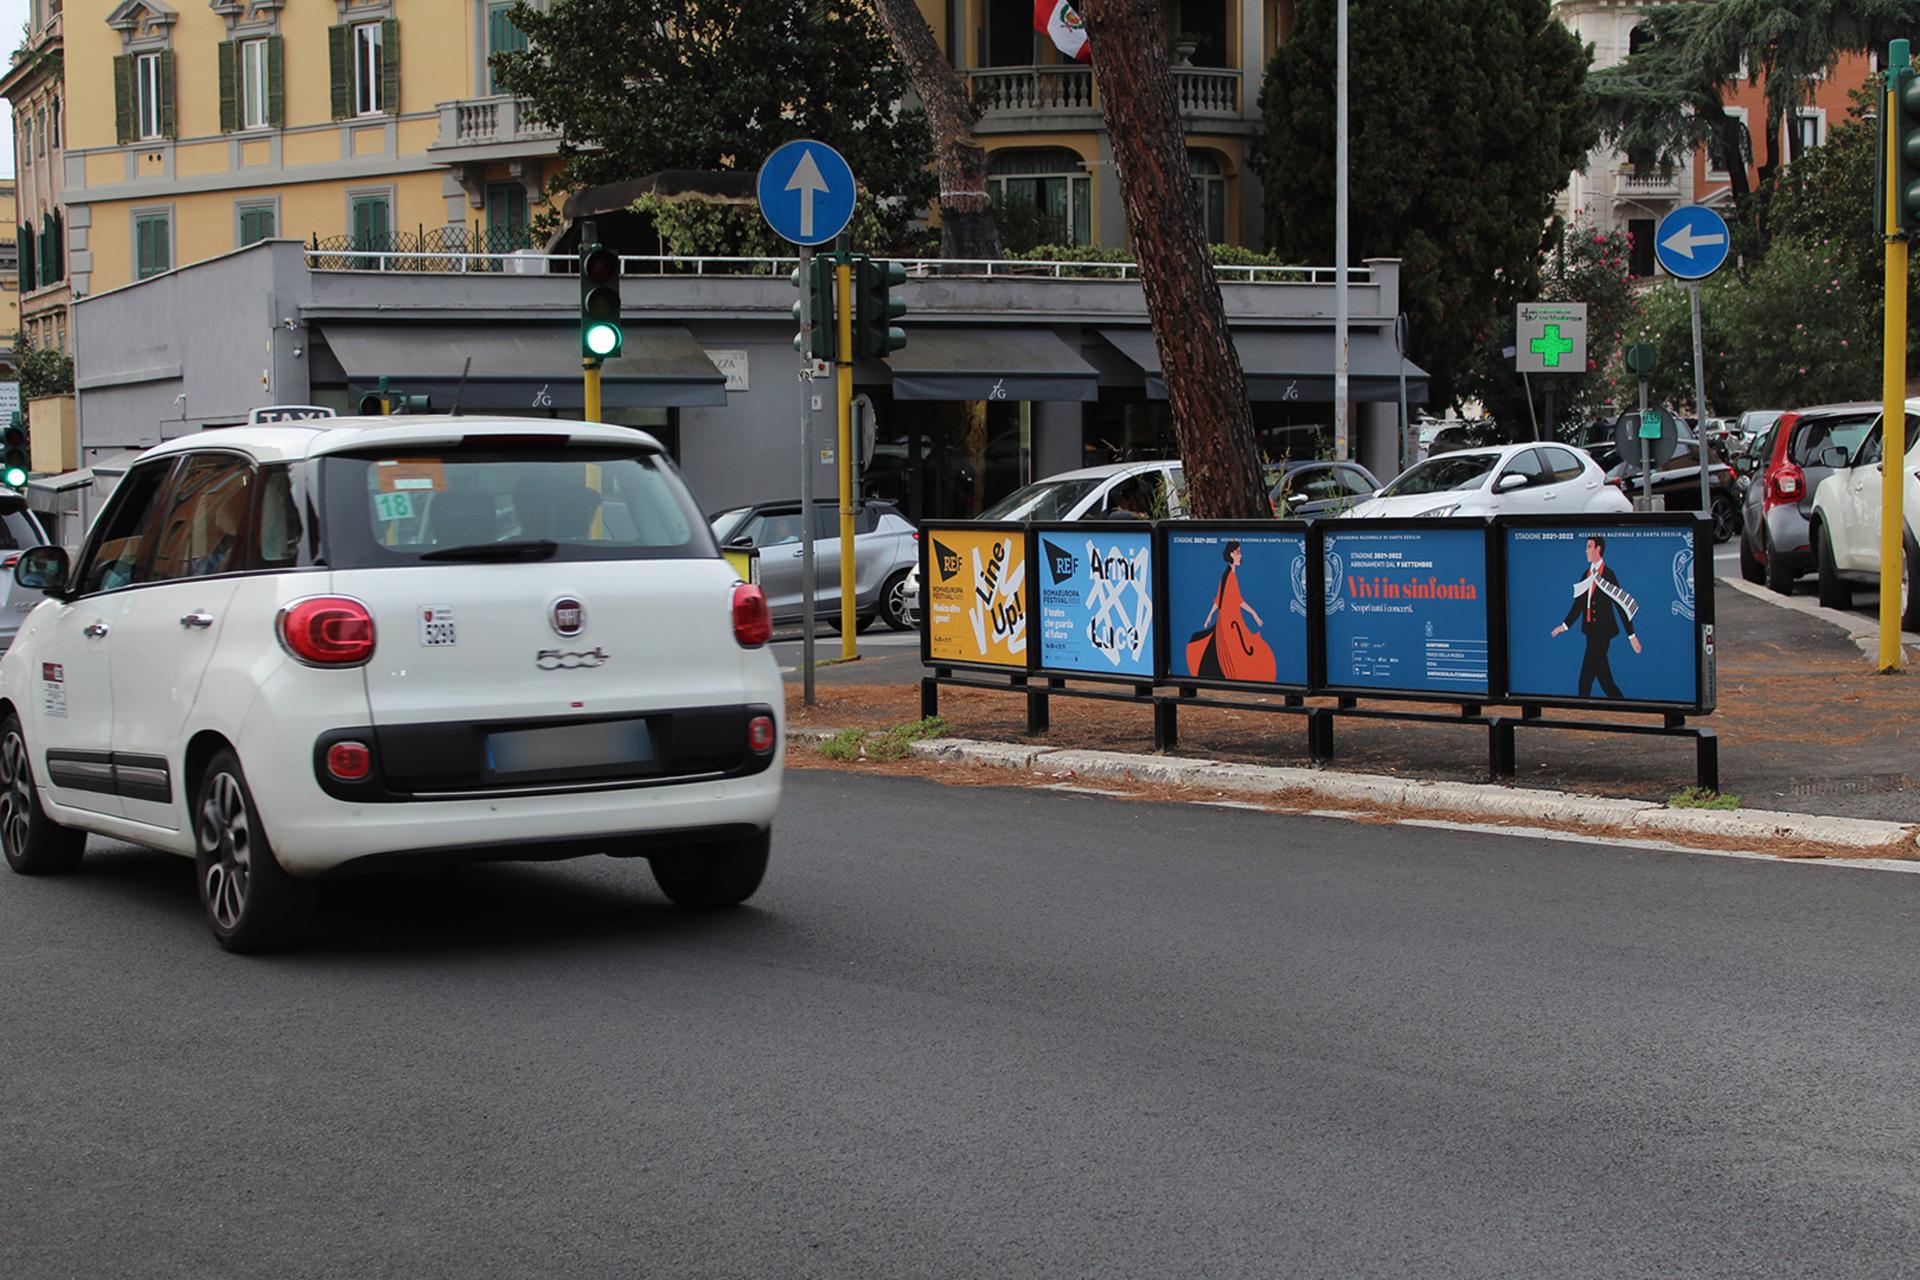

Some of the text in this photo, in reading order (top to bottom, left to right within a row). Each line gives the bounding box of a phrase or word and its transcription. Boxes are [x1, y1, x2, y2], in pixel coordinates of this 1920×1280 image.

[260, 412, 326, 423] TAXI
[379, 494, 408, 517] 18
[1515, 532, 1573, 540] STAGIONE 2021-2022
[975, 541, 1006, 606] Line
[1401, 561, 1433, 569] SETTEMBRE
[1348, 576, 1477, 600] Vivi in sinfonia
[557, 609, 580, 626] FIAT
[990, 592, 1025, 635] Up!
[1091, 616, 1140, 650] Luce
